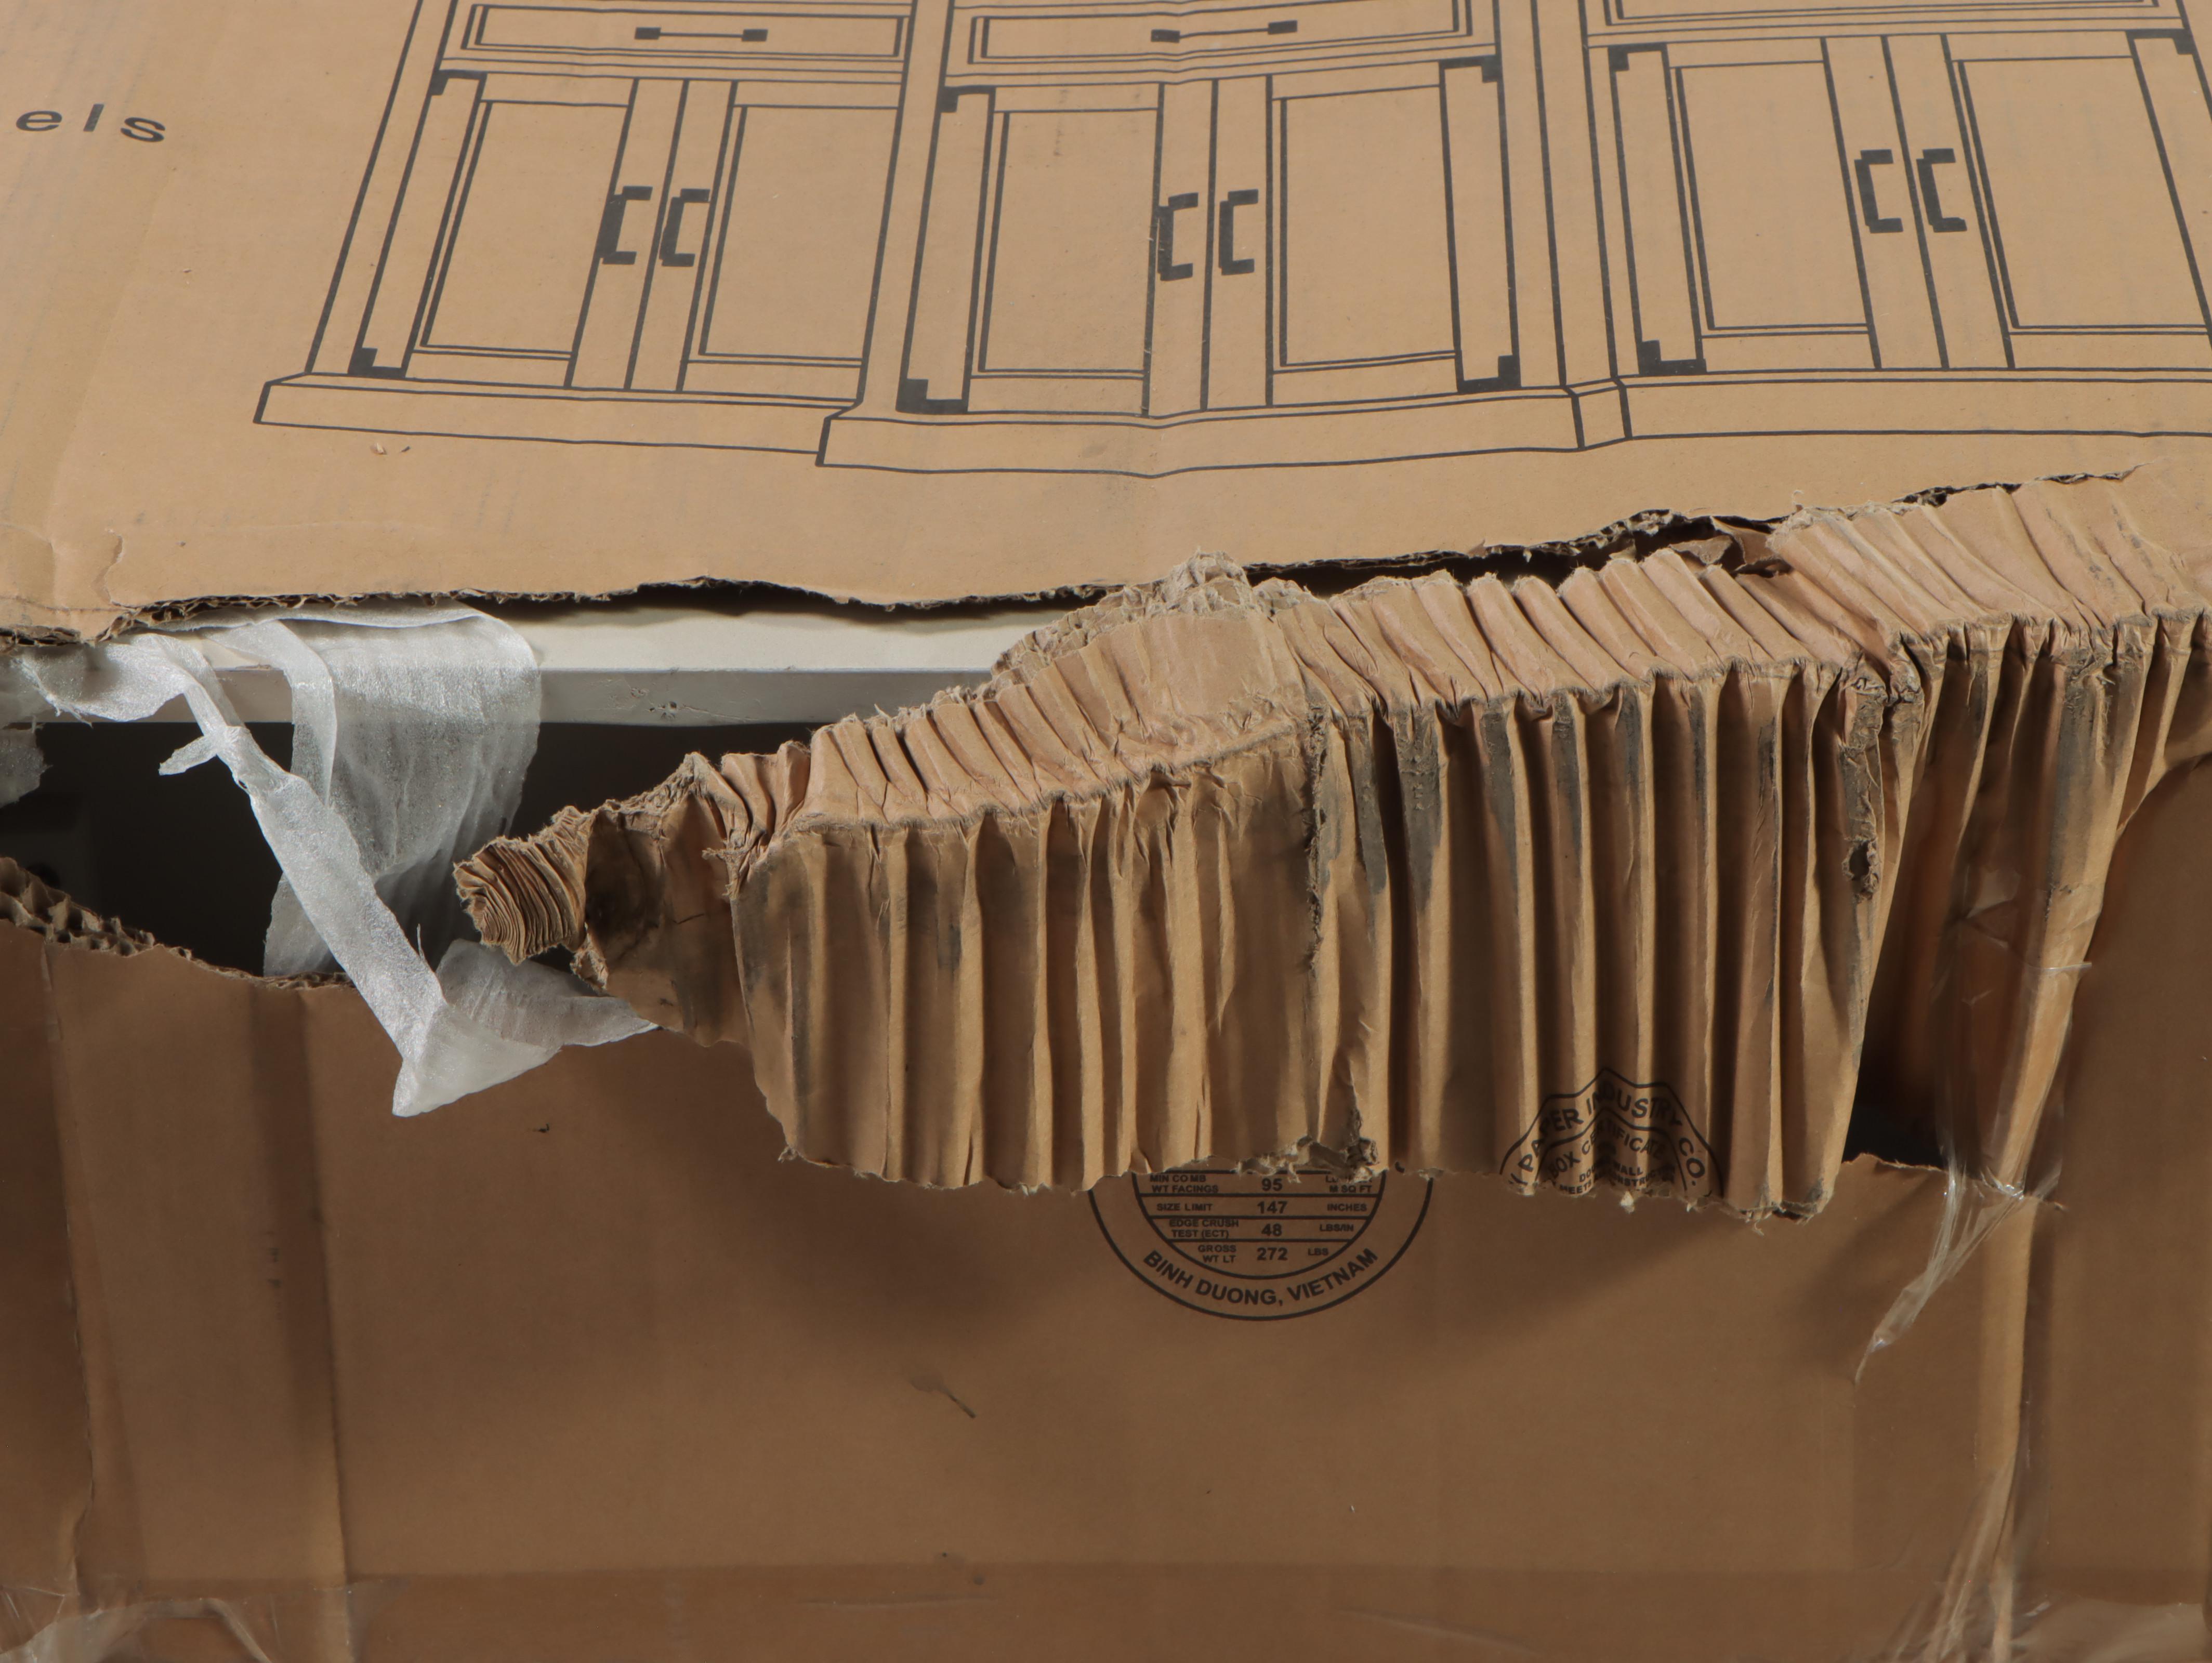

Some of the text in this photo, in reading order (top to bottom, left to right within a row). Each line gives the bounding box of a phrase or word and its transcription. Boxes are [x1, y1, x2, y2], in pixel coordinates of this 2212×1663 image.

[16, 103, 166, 142] els
[1518, 1107, 1584, 1172] PAPER
[1679, 1137, 1706, 1185] CO.
[1173, 1185, 1219, 1193] FACINGS
[1261, 1178, 1283, 1191] 95
[1257, 1201, 1288, 1214] 147
[1327, 1204, 1367, 1212] INCHES
[1170, 1219, 1240, 1227] EDGE CRUSH
[1261, 1223, 1282, 1236] 48
[1201, 1230, 1229, 1239] (ECT)
[1197, 1245, 1237, 1253] GROSS
[1257, 1248, 1288, 1261] 272
[1308, 1248, 1329, 1256] LBS
[1143, 1248, 1378, 1306] BINH DUONG, VIETNAM
